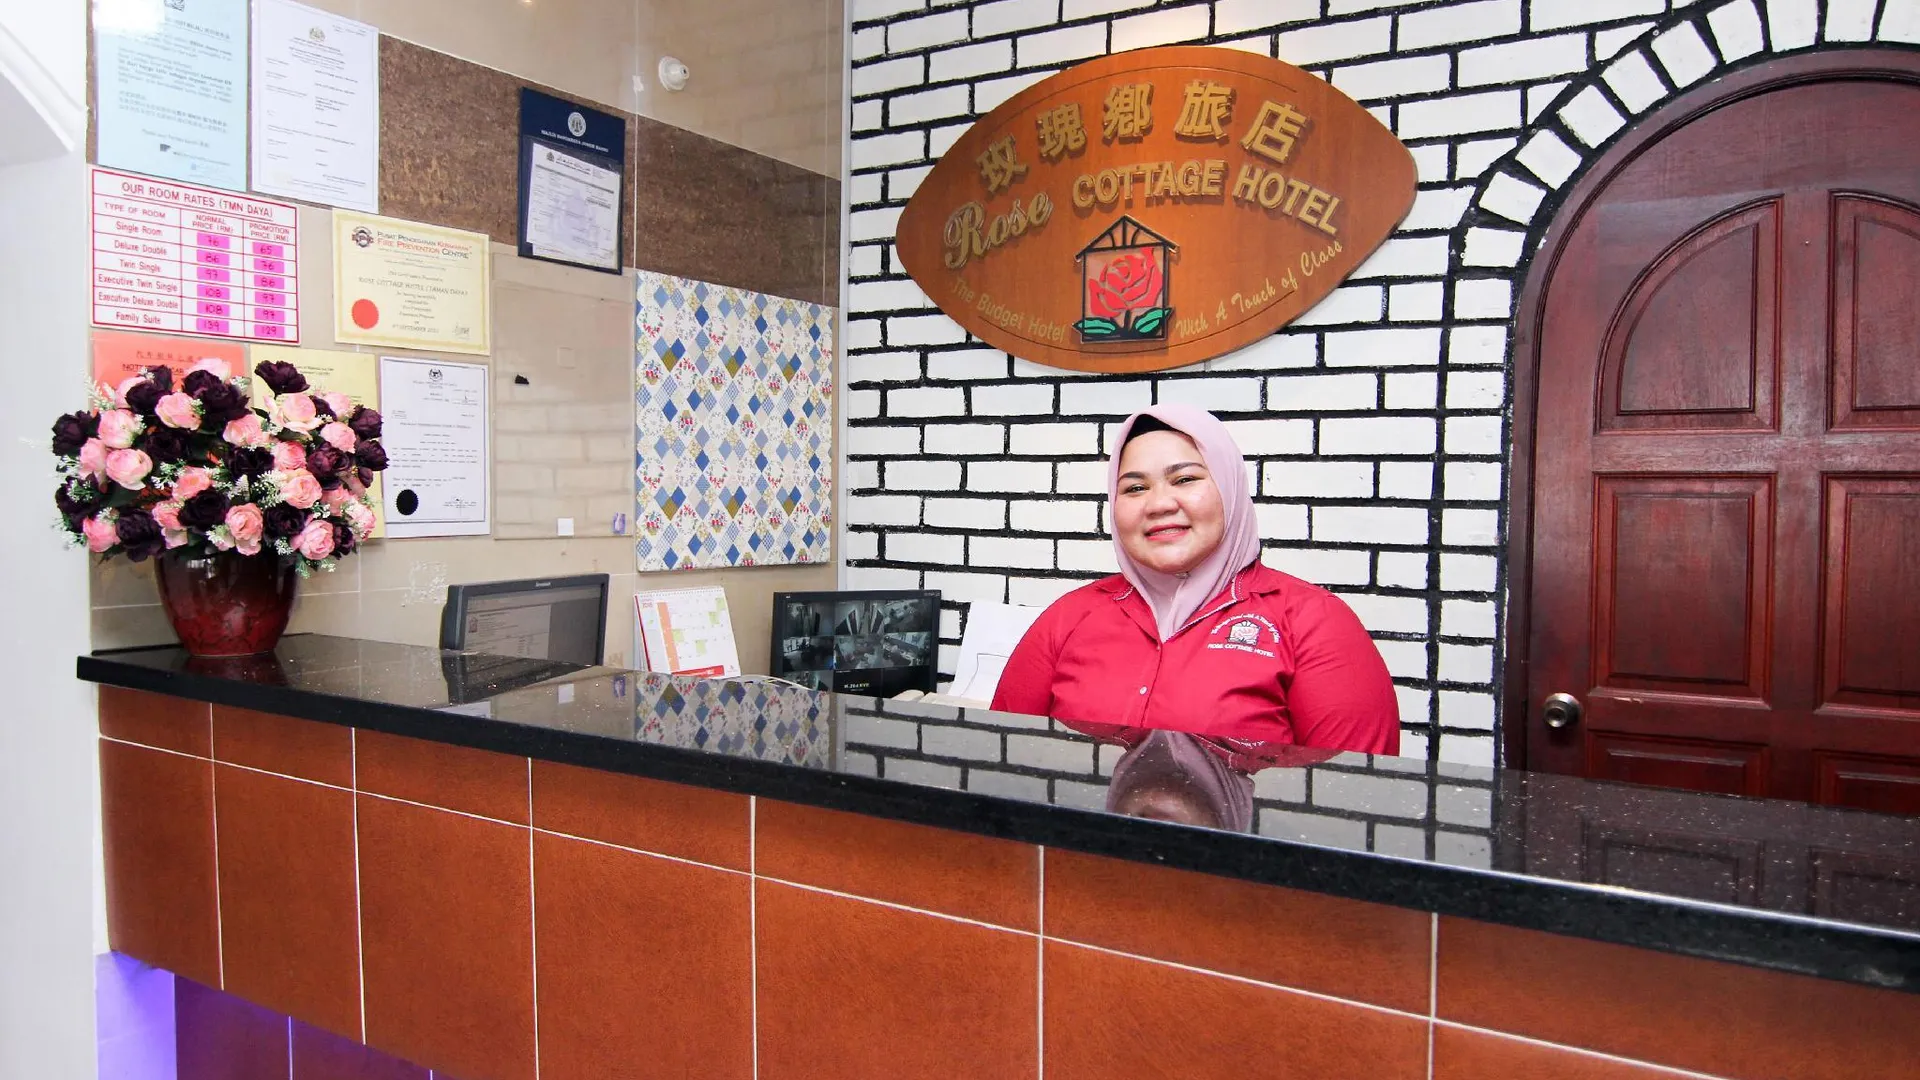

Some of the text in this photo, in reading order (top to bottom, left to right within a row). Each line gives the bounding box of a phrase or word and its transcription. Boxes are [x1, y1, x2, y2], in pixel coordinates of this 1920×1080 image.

[976, 80, 1308, 193] 玫瑰鄉旅店
[122, 182, 273, 217] OUR ROOM RATES (TMN DAYA)
[104, 202, 166, 218] TYPE OF ROOM
[943, 160, 1341, 268] Rose COTTAGE HOTEL
[192, 221, 213, 230] PRICE
[196, 215, 226, 225] NORMAL
[116, 221, 163, 236] Single Room
[249, 223, 290, 235] PROMOTION
[250, 231, 270, 240] PRICE
[114, 240, 167, 256] Deluxe Double
[120, 259, 161, 273] Twin Single
[98, 274, 178, 292] Executive Twin Single
[1175, 240, 1343, 339] With A Touch of Class
[98, 292, 179, 309] Executive Deluxe Double
[205, 288, 222, 298] 108
[206, 304, 223, 315] 108
[951, 277, 1067, 342] The Budget Hotel
[116, 312, 161, 324] Family Suite
